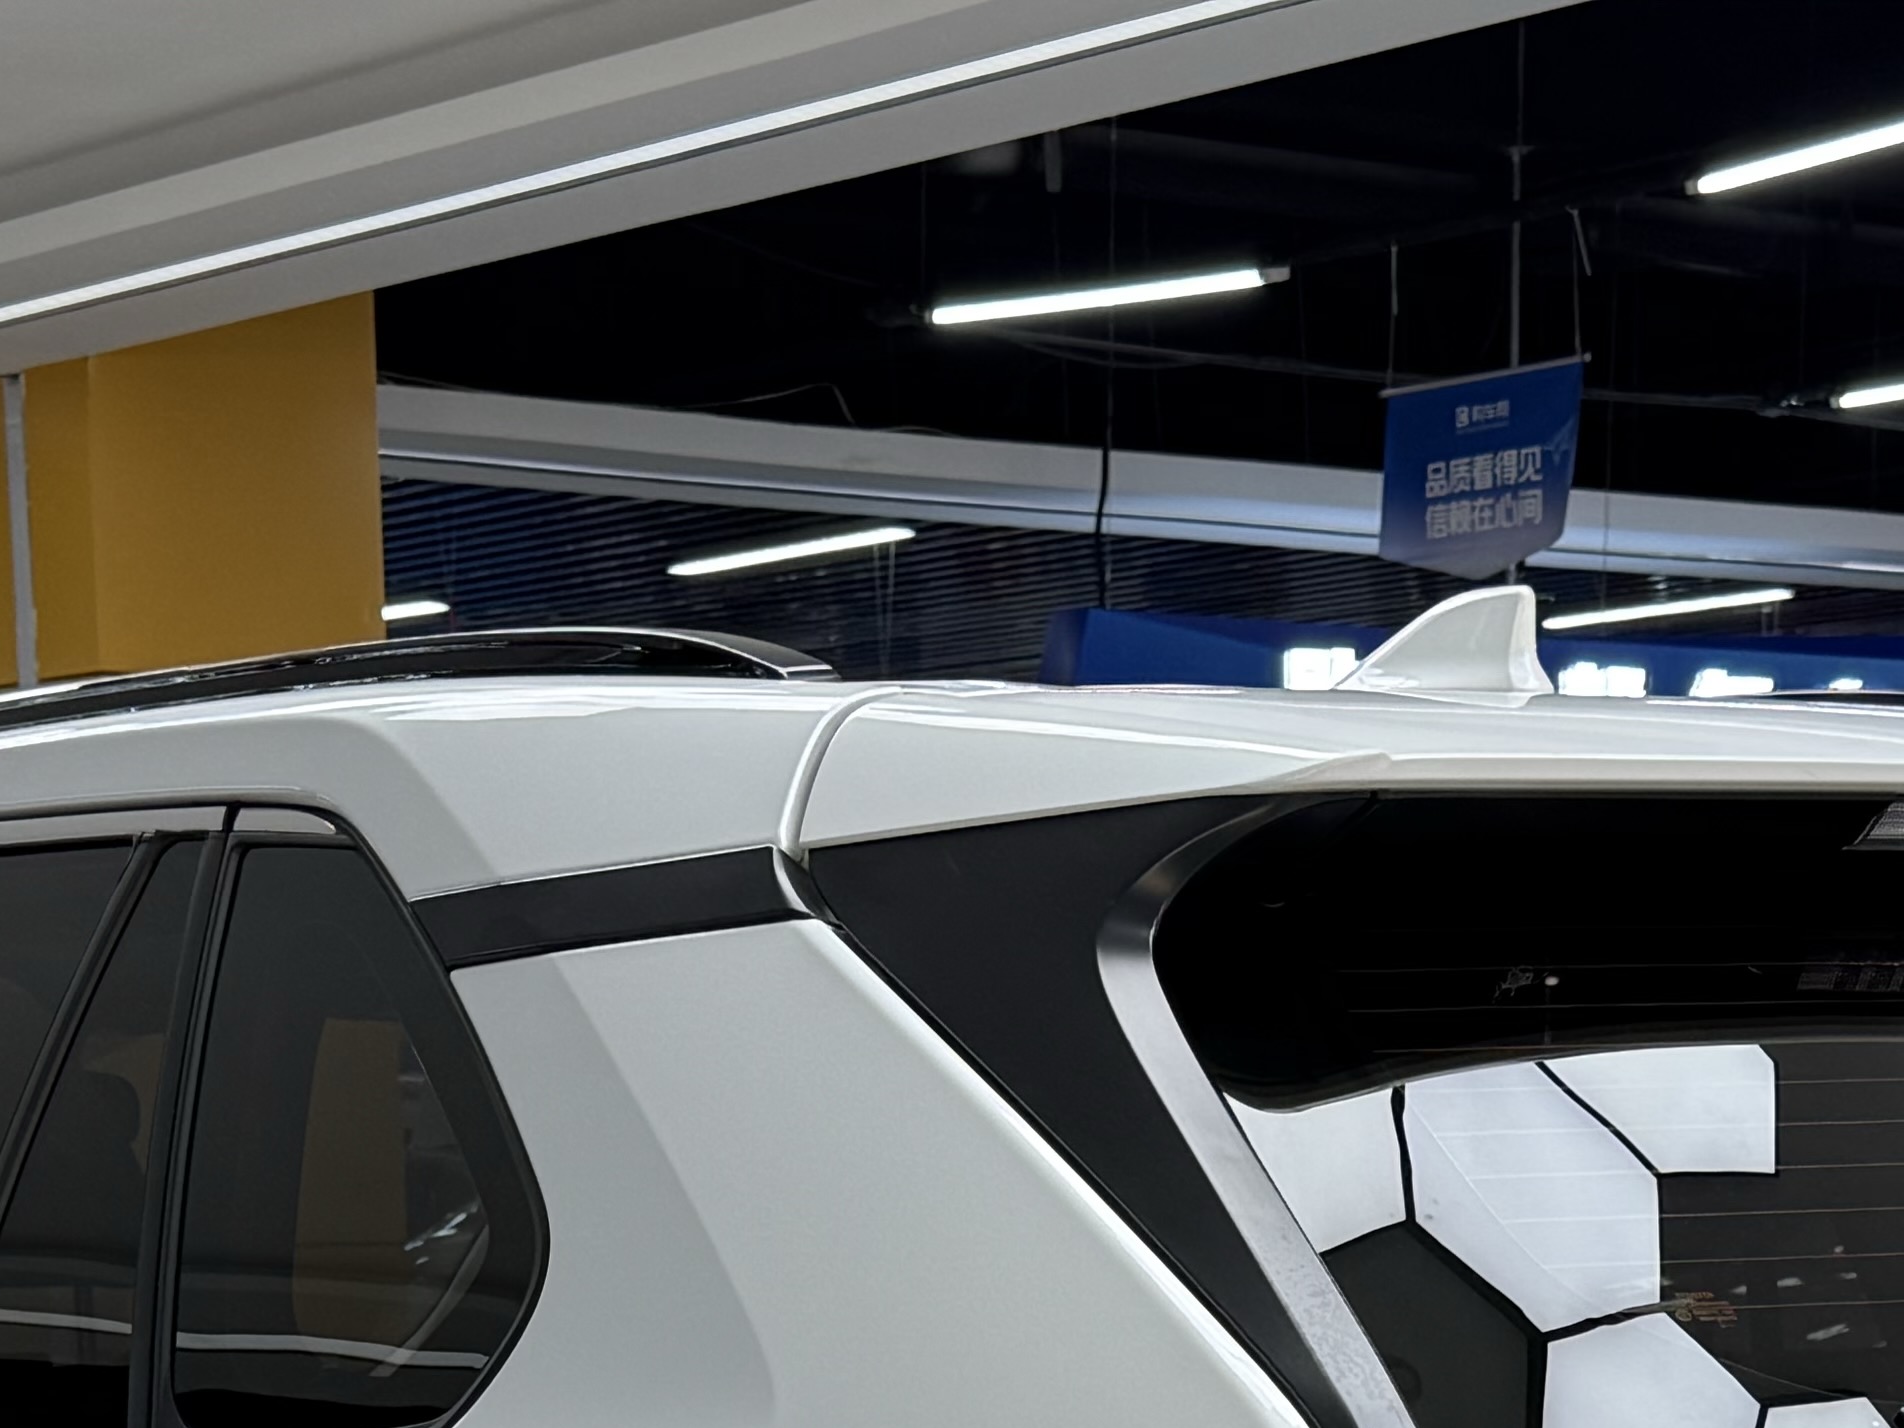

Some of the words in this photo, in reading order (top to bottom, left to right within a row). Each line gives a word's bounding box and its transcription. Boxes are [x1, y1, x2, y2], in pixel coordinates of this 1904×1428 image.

[1425, 444, 1543, 499] 品质看得见
[1425, 488, 1543, 540] 信赖在心间
